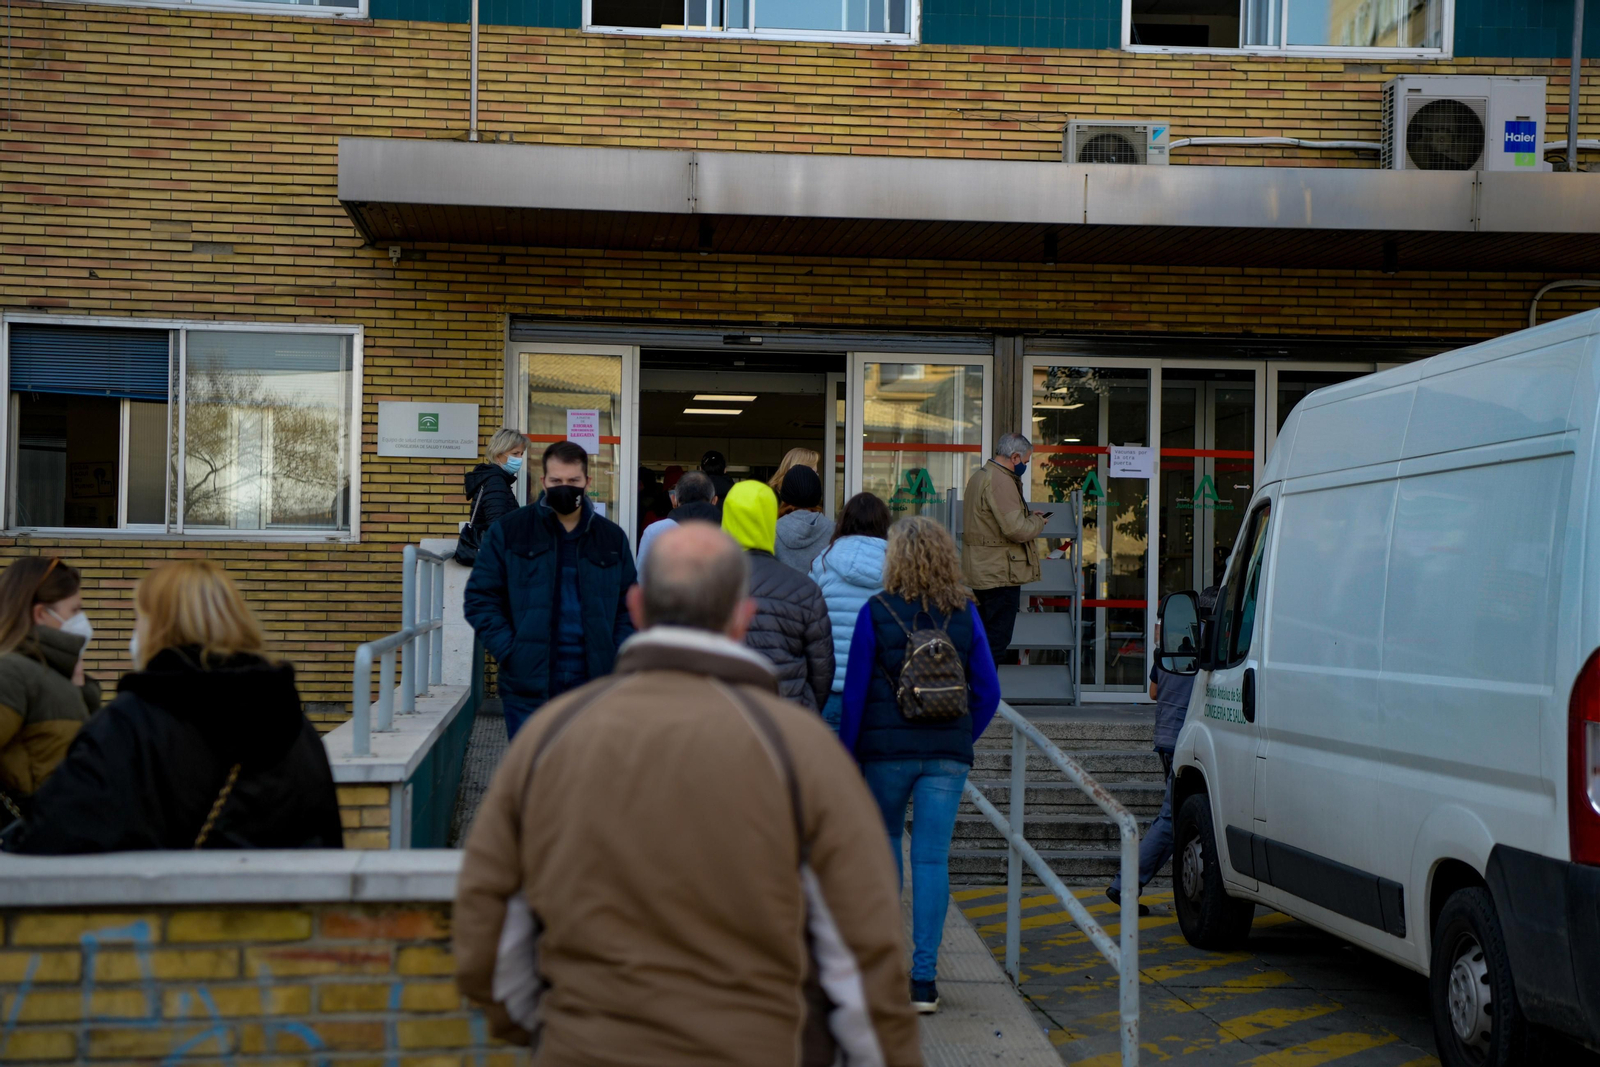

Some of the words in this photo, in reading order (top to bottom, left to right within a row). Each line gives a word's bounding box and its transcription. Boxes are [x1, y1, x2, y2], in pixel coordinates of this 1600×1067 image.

[1505, 132, 1535, 142] Haier
[1218, 686, 1230, 701] Andaluz
[1231, 687, 1235, 701] de
[1227, 707, 1232, 722] DE
